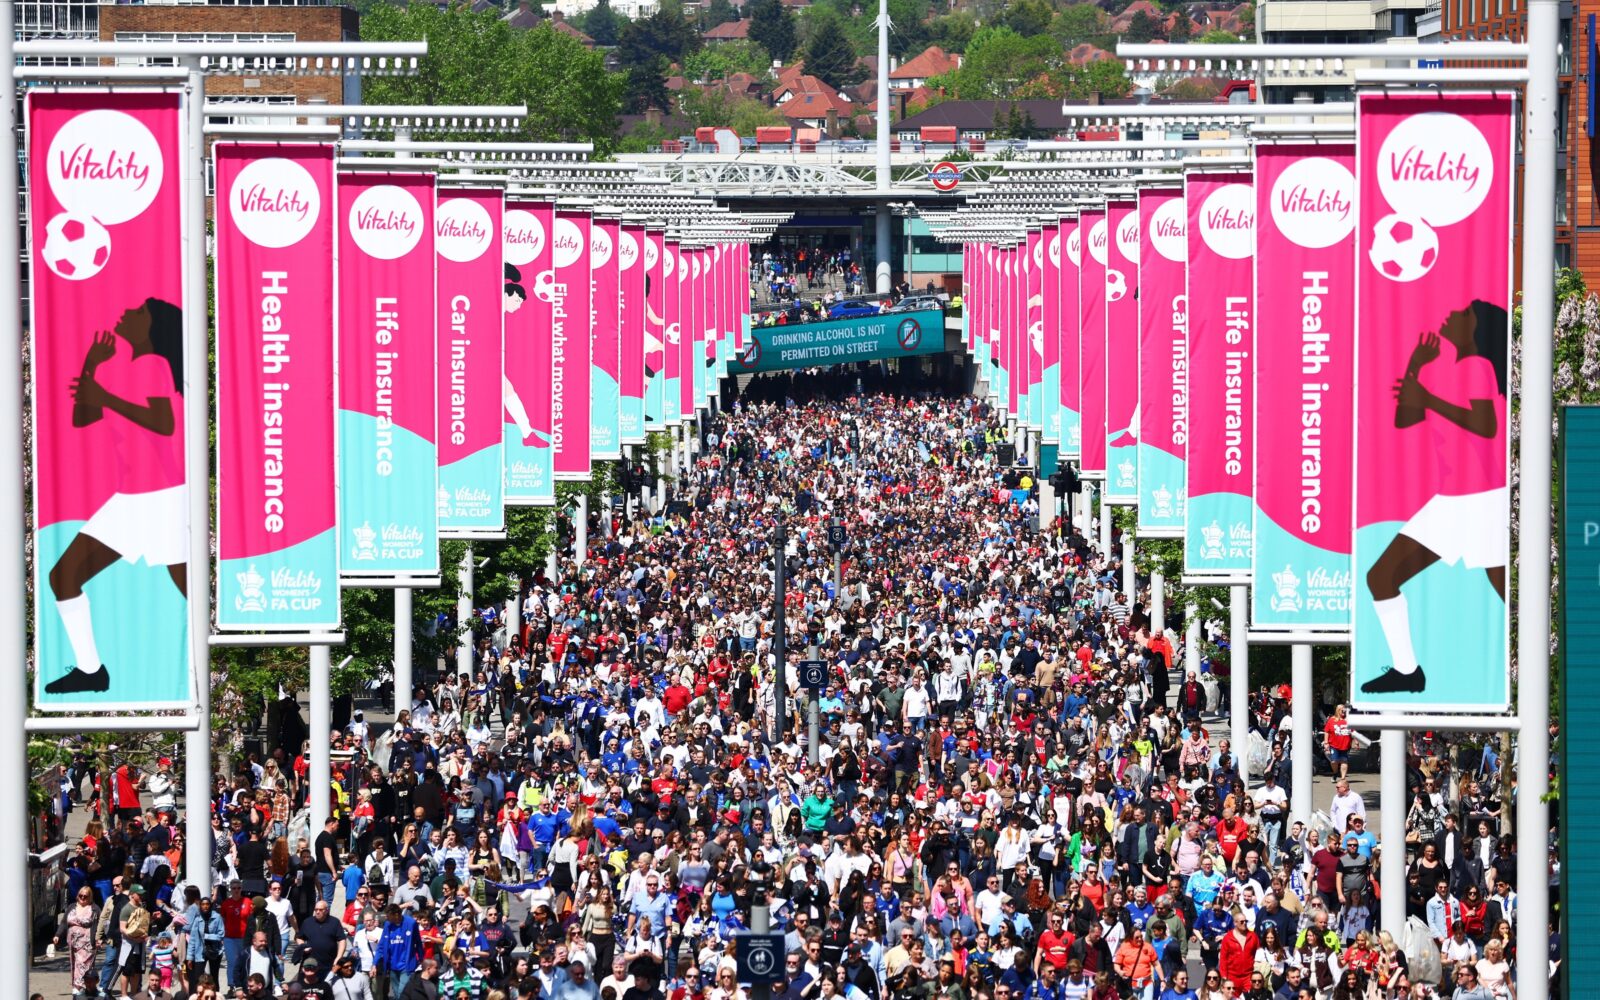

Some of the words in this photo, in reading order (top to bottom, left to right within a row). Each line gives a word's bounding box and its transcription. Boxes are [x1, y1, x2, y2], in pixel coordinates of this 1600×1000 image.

[60, 144, 149, 191] Vitality
[1390, 145, 1480, 191] Vitality
[241, 183, 310, 219] Vitality
[1281, 184, 1351, 220] Vitality
[357, 207, 415, 236] Vitality
[437, 217, 485, 243] Vitality
[451, 294, 471, 335] Car
[553, 283, 568, 318] Find
[1172, 294, 1186, 335] Car
[261, 271, 291, 374] Health
[375, 297, 398, 345] Life
[772, 329, 814, 346] DRINKING
[815, 326, 856, 342] ALCOHOL
[857, 325, 867, 337] IS
[868, 323, 886, 336] NOT
[1225, 296, 1249, 345] Life
[1302, 271, 1330, 374] Health
[553, 322, 568, 364] what
[781, 346, 830, 361] PERMITTED
[833, 344, 845, 357] ON
[847, 340, 879, 355] STREET
[451, 339, 471, 446] insurance
[553, 366, 563, 420] moves
[1172, 339, 1186, 446] insurance
[375, 352, 398, 477] insurance
[1225, 351, 1249, 476] insurance
[553, 422, 563, 454] you
[262, 382, 290, 533] insurance
[1301, 383, 1330, 534] insurance
[455, 486, 491, 505] Vitality
[523, 480, 542, 488] CUP
[455, 508, 468, 517] FA
[469, 508, 491, 517] CUP
[381, 522, 424, 545] Vitality
[381, 549, 397, 559] FA
[398, 549, 424, 559] CUP
[1229, 548, 1245, 558] FA
[271, 566, 321, 593] Vitality
[271, 598, 289, 610] FA
[290, 598, 322, 610] CUP
[1306, 598, 1325, 610] FA
